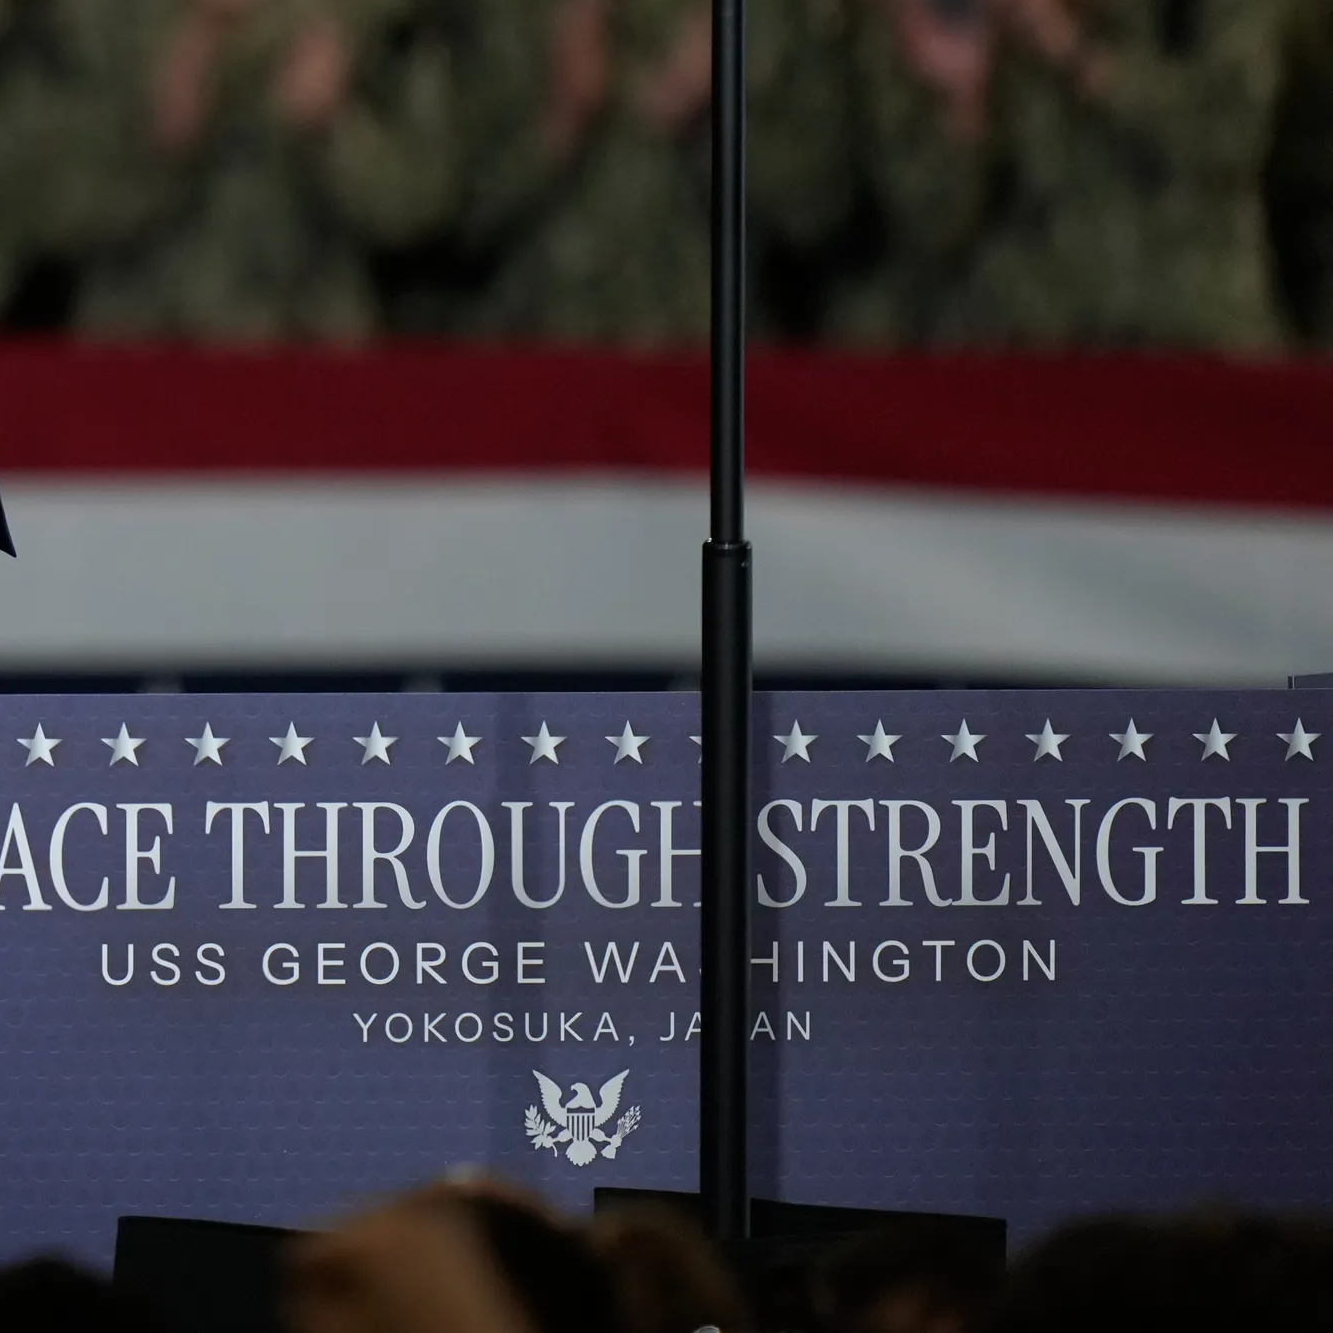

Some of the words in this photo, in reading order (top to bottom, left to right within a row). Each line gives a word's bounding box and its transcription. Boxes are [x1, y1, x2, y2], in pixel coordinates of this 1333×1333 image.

[757, 796, 1310, 908] STRENGTH
[101, 942, 226, 986] USS
[262, 941, 546, 986] GEORGE
[584, 939, 1056, 984] WAHINGTON
[352, 1011, 635, 1047] YOKOSUKA,
[660, 1011, 810, 1042] JAAN
